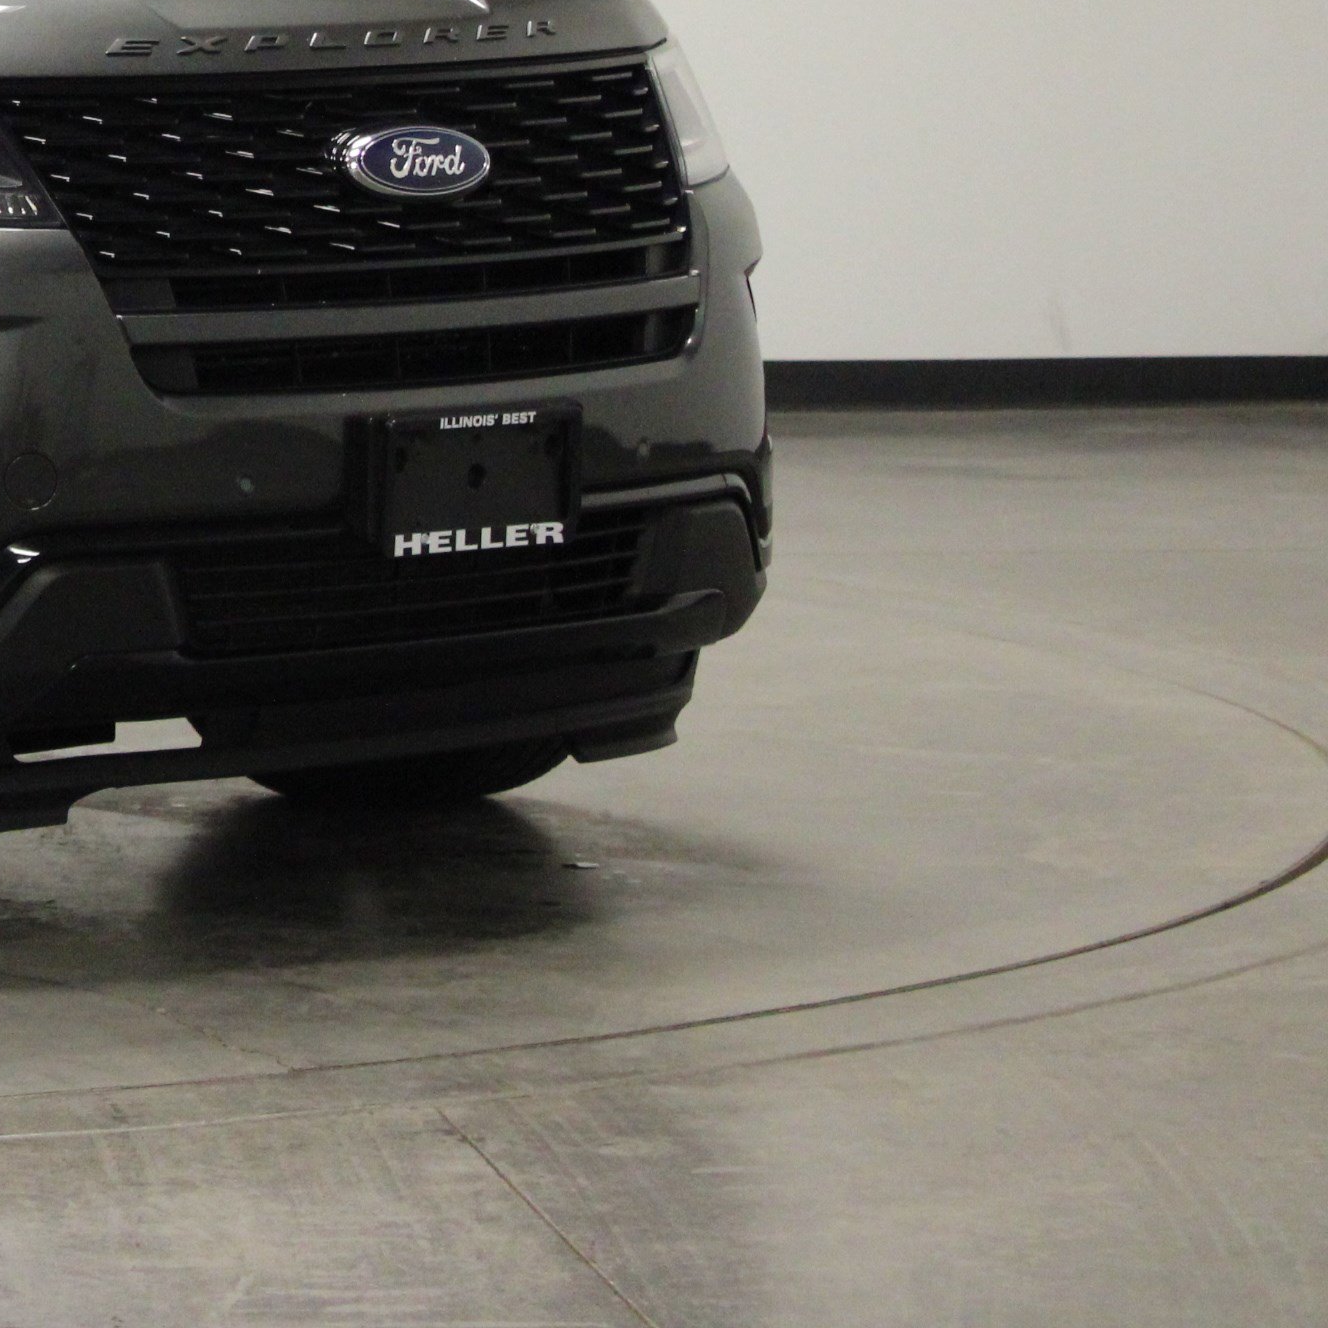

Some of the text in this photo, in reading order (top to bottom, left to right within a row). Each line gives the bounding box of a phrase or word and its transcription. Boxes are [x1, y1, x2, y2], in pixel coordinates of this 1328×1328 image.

[104, 19, 558, 57] EXPLORER
[389, 136, 466, 179] Ford
[439, 411, 537, 430] ILLINOIS' BEST
[393, 521, 564, 558] HELLER
